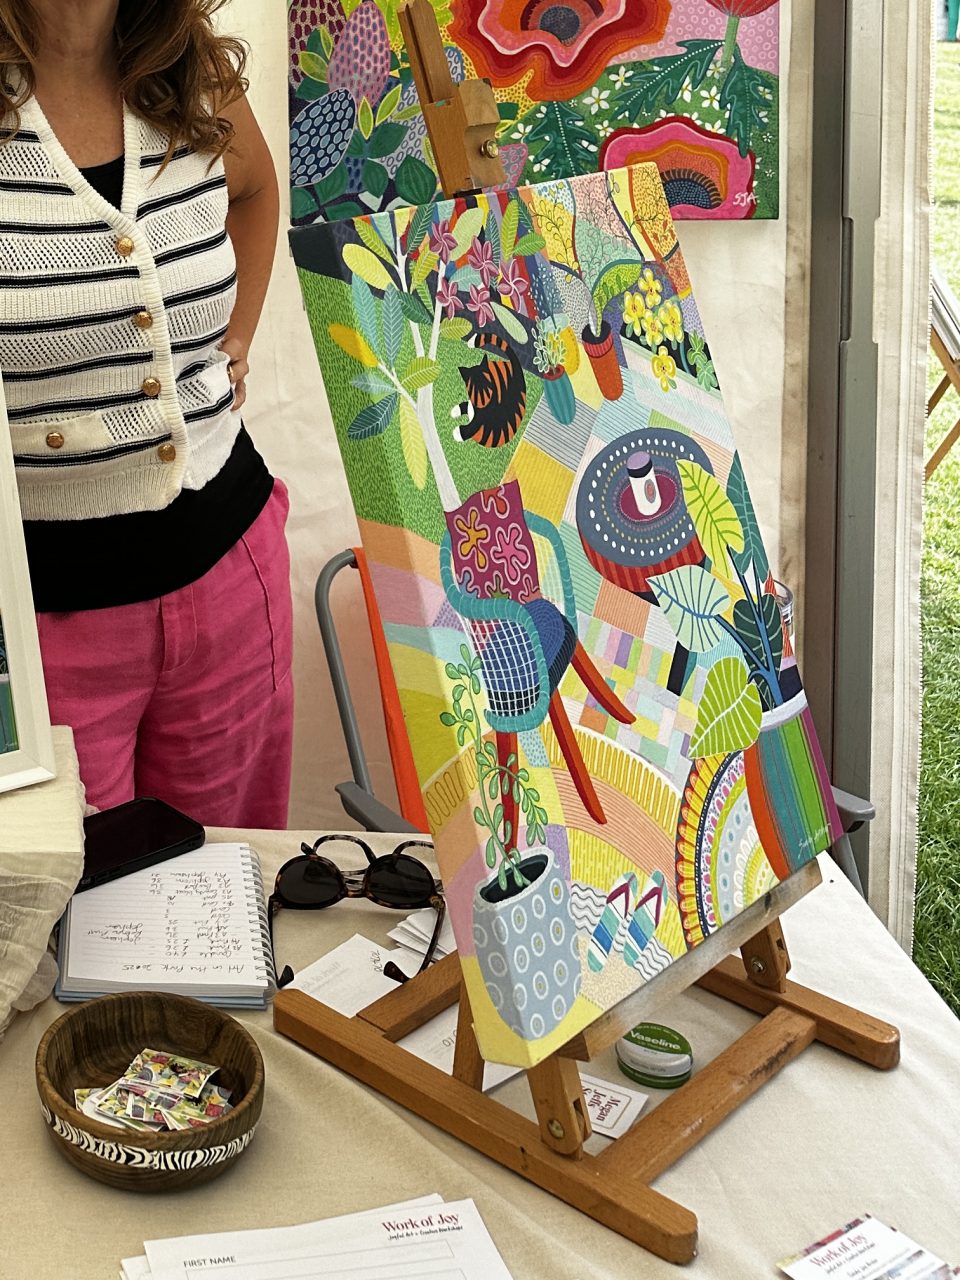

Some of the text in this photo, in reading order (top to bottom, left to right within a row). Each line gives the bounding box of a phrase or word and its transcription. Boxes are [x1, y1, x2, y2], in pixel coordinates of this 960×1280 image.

[630, 1029, 682, 1051] Vaseline
[596, 1095, 621, 1122] Megan
[381, 1213, 459, 1232] Work of Joy
[183, 1255, 236, 1268] FIRST NAME
[809, 1249, 841, 1267] Work
[847, 1235, 868, 1246] Joy
